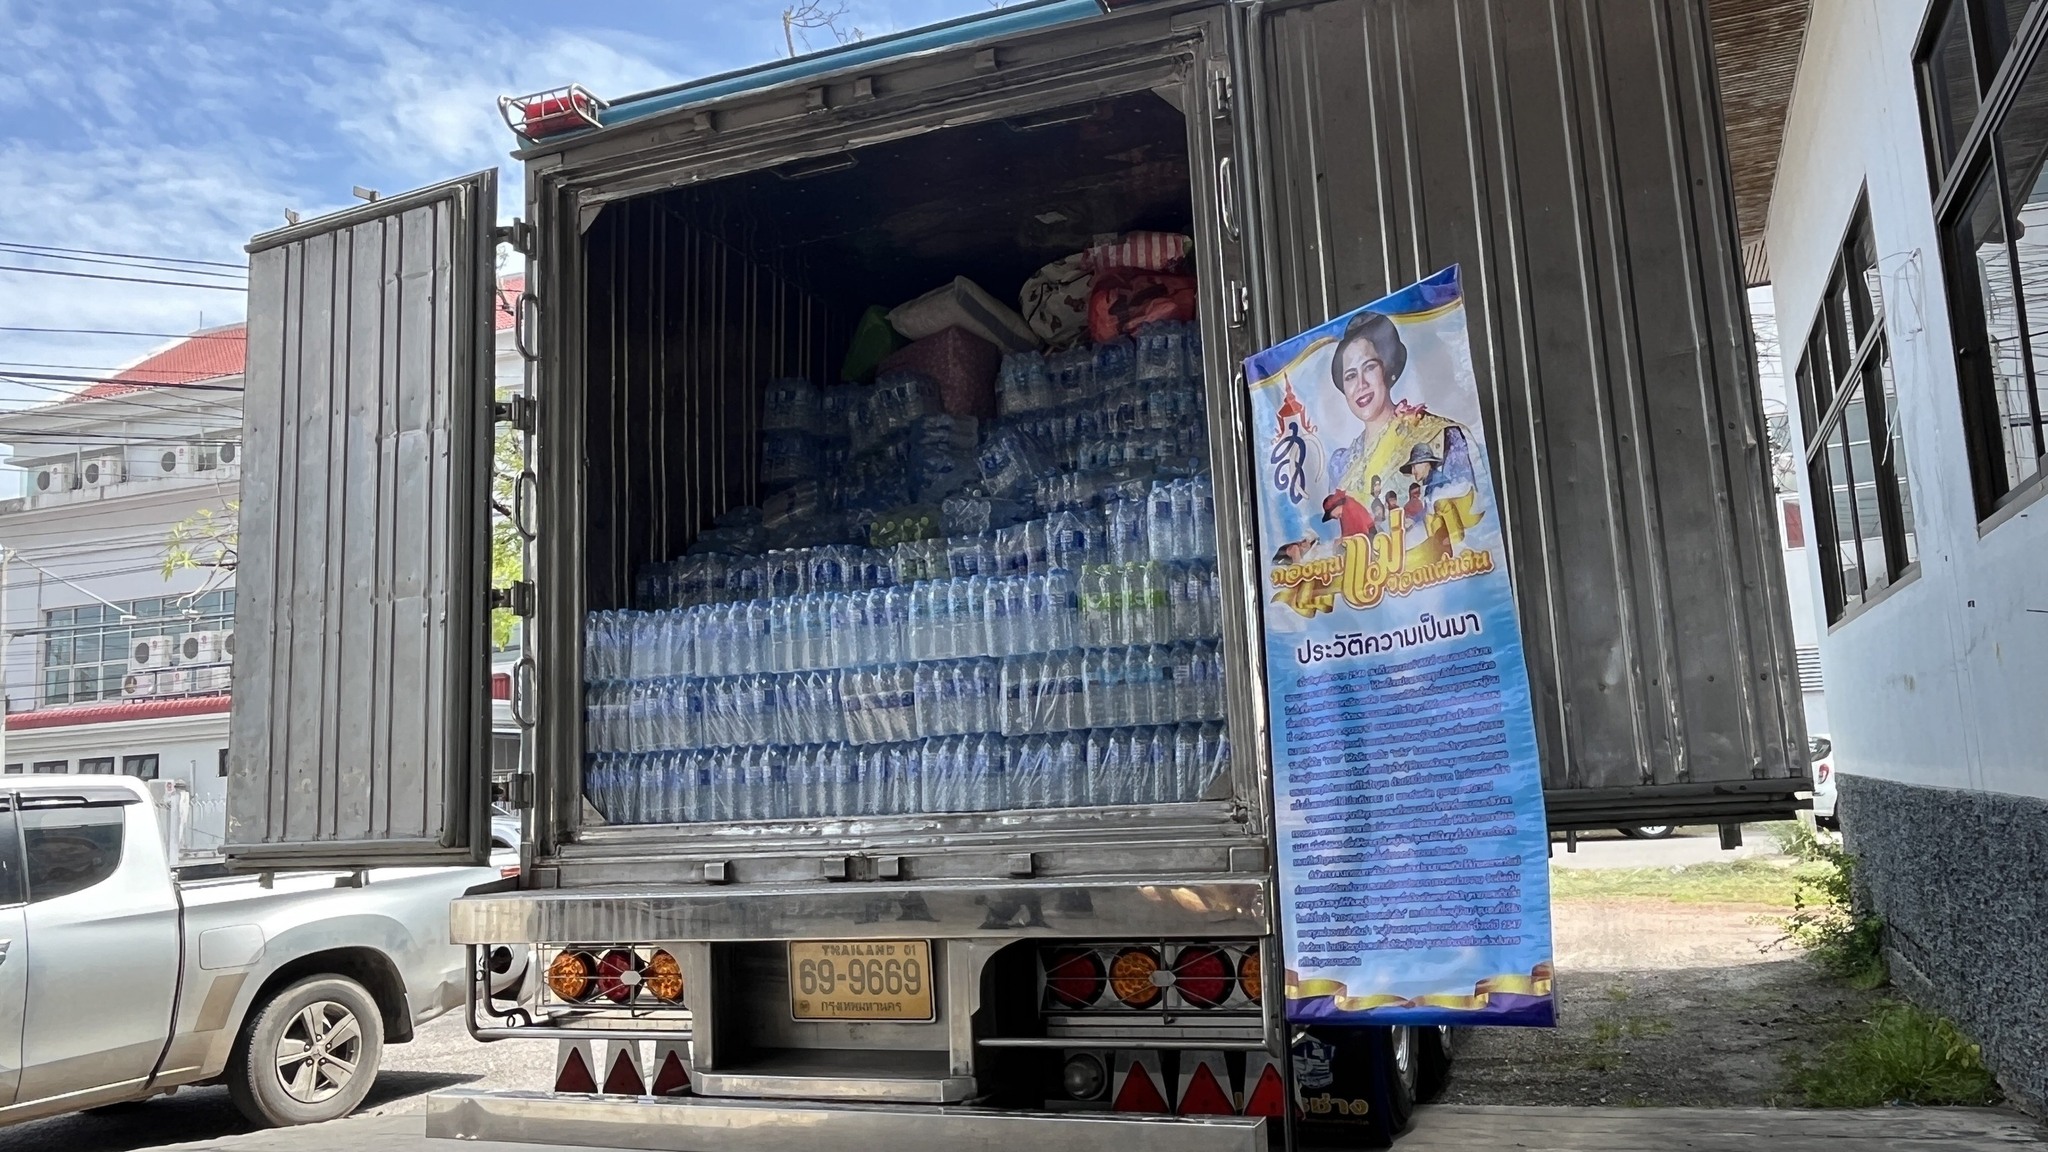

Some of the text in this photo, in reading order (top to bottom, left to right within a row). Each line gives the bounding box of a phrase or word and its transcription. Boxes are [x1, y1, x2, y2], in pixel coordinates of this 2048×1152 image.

[1297, 612, 1480, 664] ประวัติความเป็นมา
[822, 944, 916, 956] THAILAND 01
[799, 958, 921, 995] 69-9669
[821, 1001, 902, 1015] กรุงเทพมหานคร
